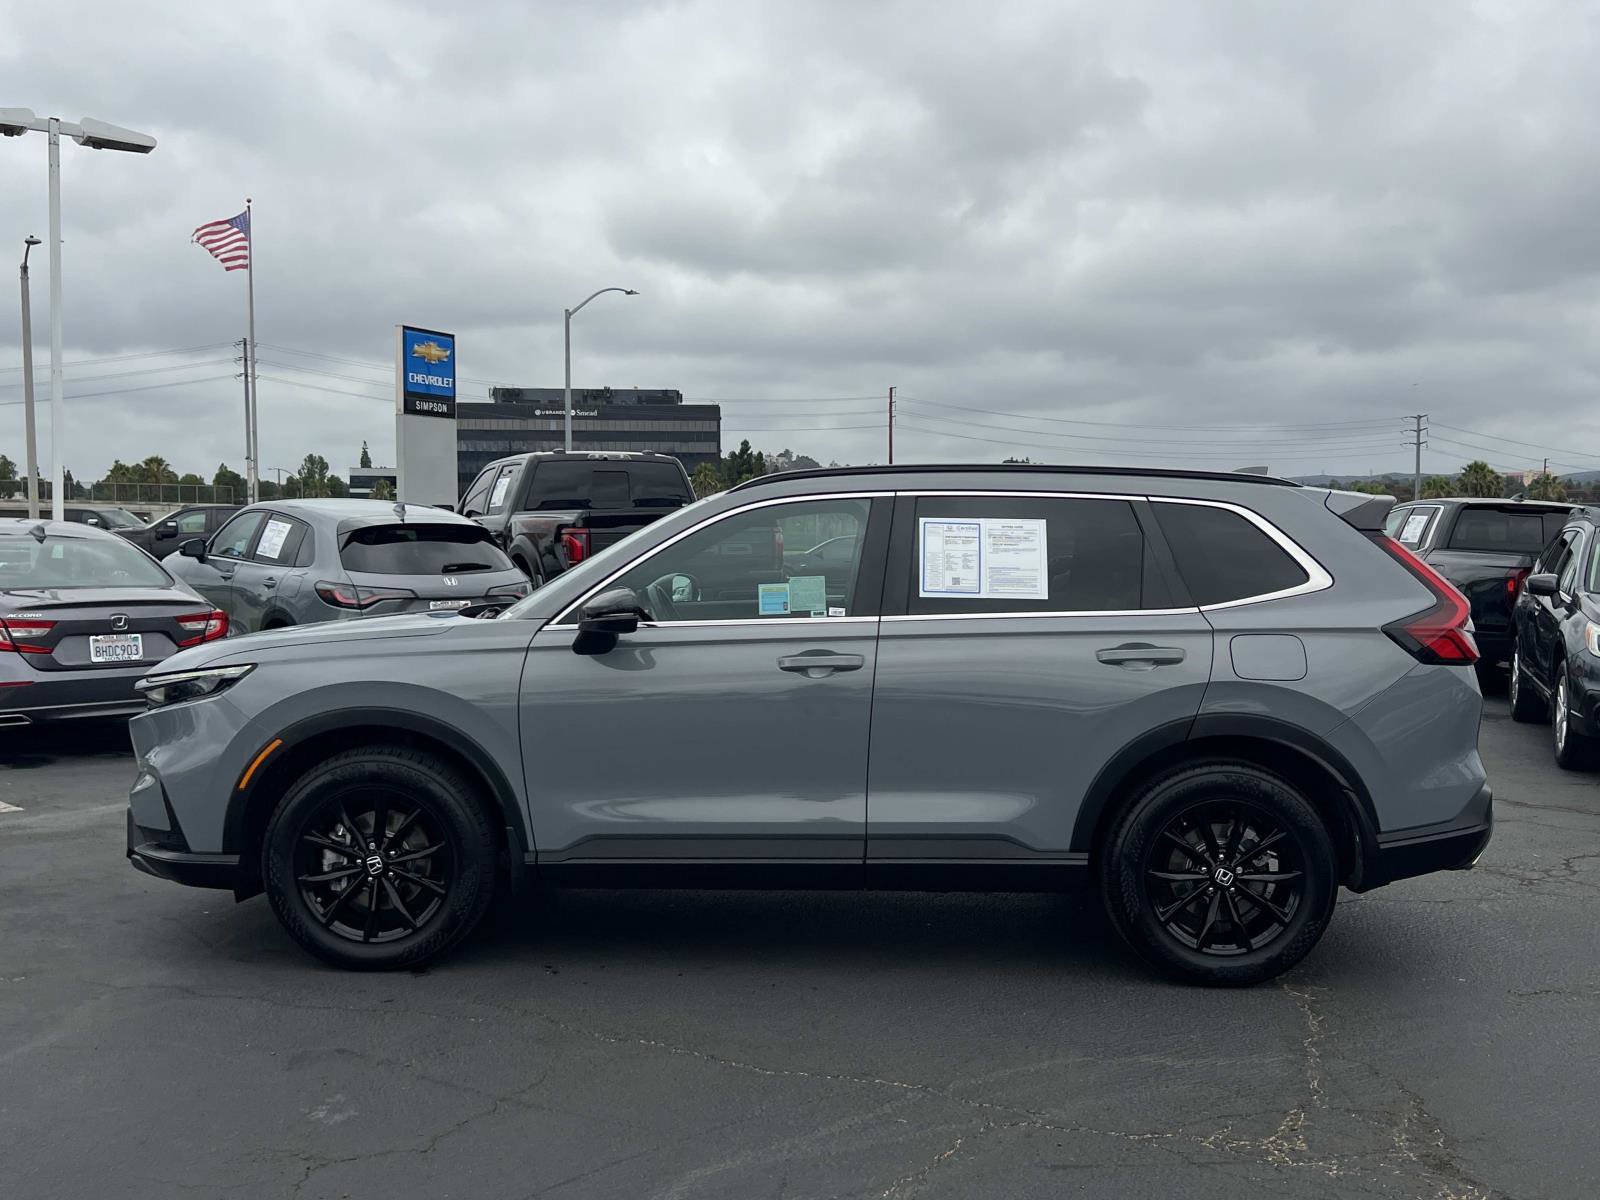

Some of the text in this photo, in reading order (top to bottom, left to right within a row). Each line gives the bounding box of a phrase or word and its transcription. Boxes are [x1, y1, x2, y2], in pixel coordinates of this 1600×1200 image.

[408, 372, 453, 388] CHEVROLET
[415, 400, 448, 413] SIMPSON
[95, 644, 139, 658] 8HDC903
